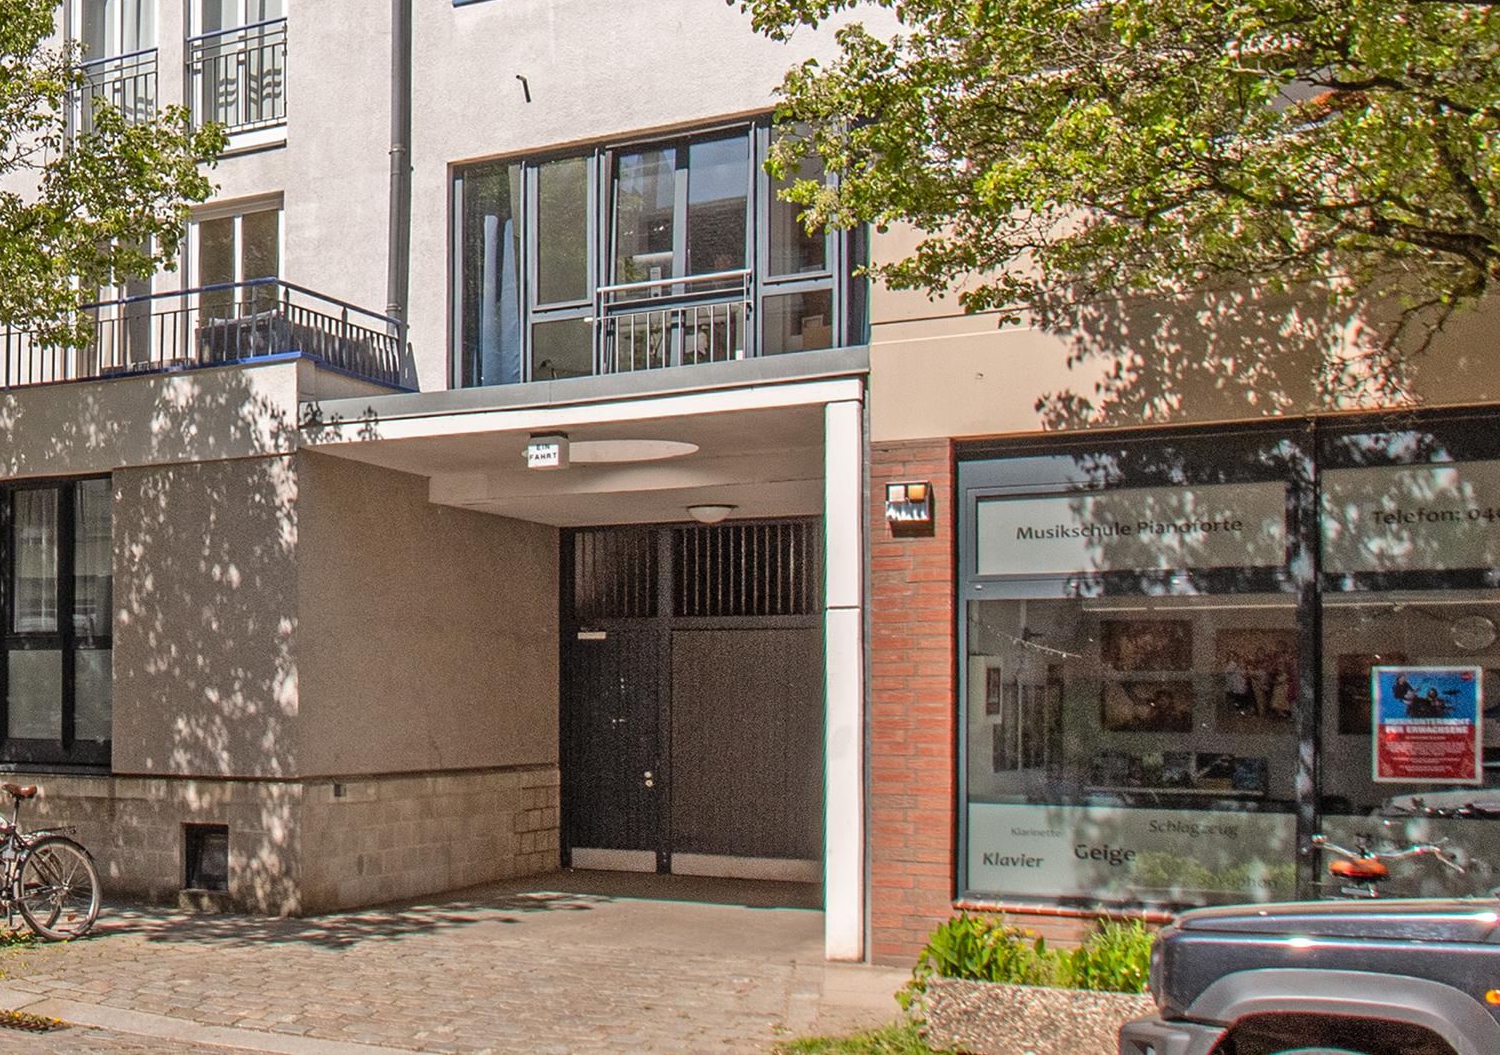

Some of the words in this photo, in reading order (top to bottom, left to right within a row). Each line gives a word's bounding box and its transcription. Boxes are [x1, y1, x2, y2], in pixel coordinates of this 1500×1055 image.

[529, 452, 557, 460] FAHRT
[1016, 521, 1131, 539] Musikschule
[1137, 519, 1243, 535] Pianoforte
[1011, 827, 1063, 838] Klarinette
[982, 852, 1044, 867] Klavier
[1074, 844, 1135, 866] Geige
